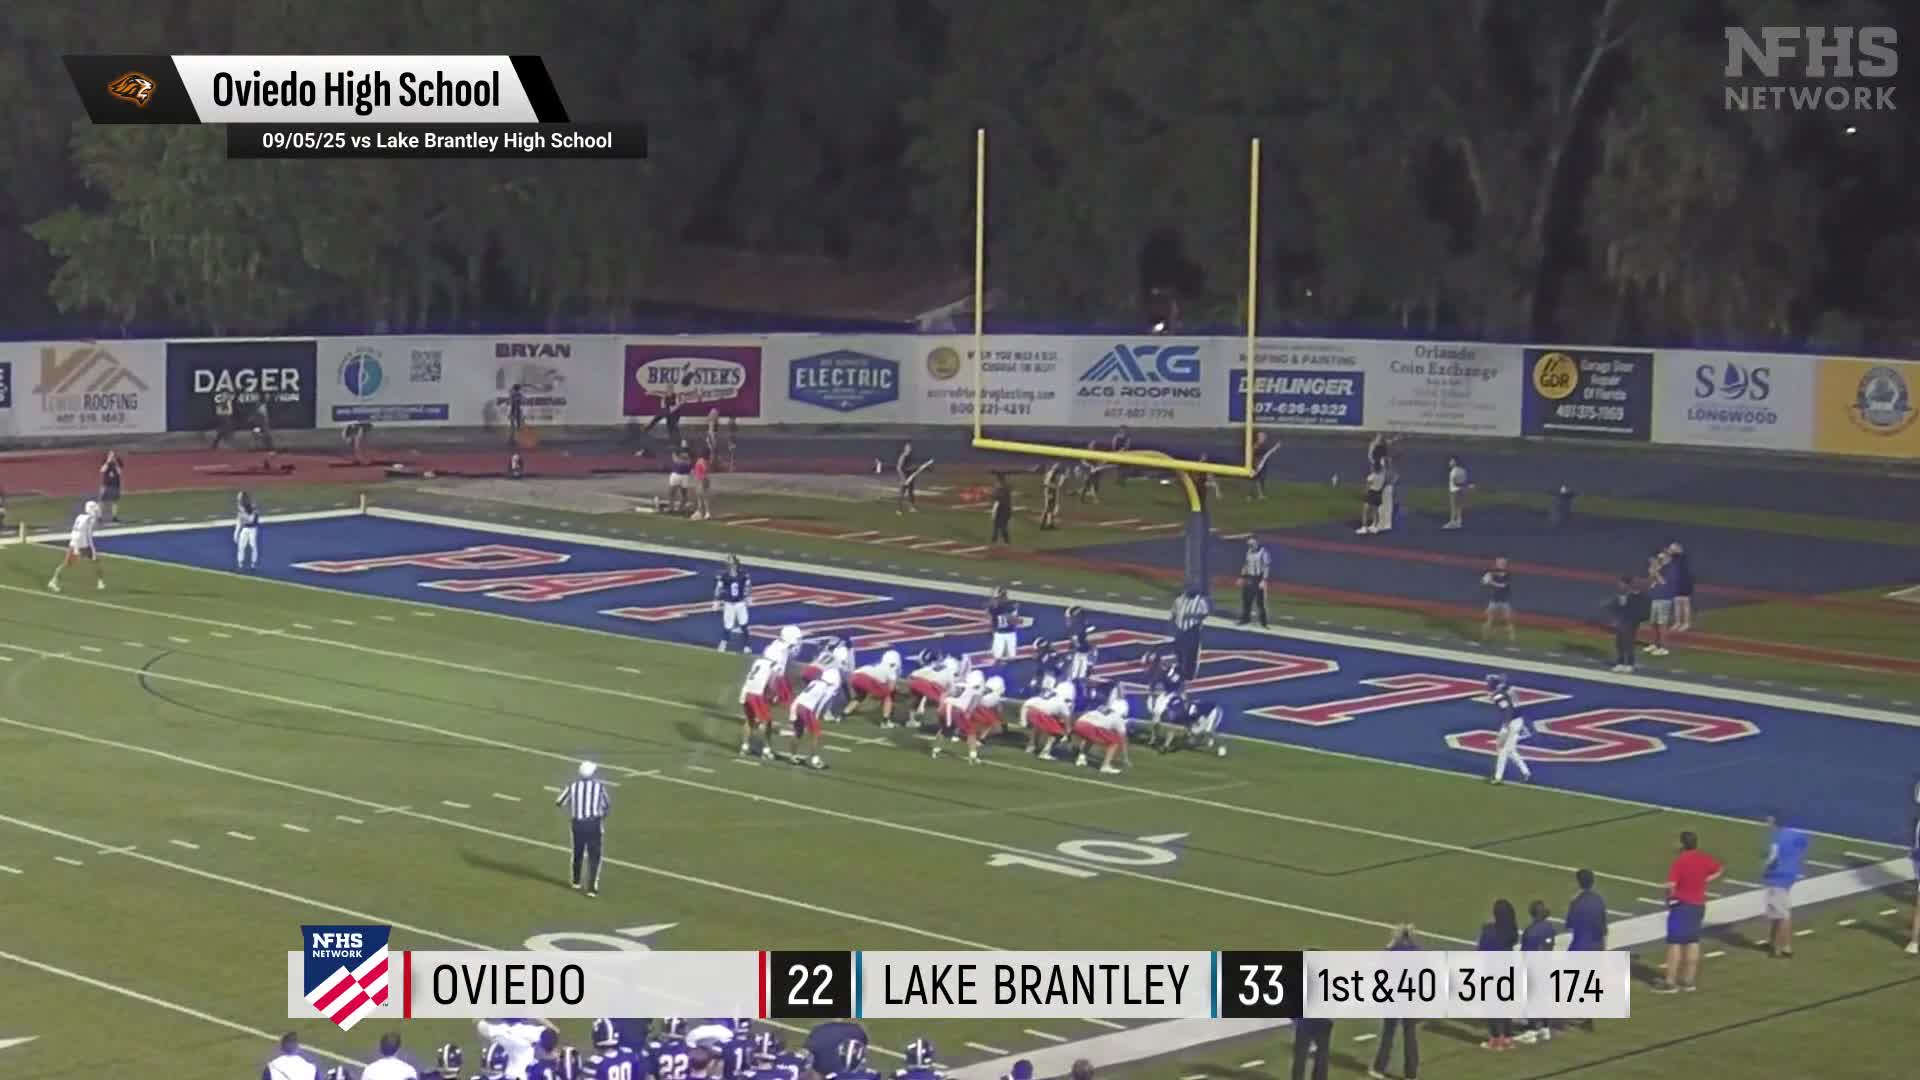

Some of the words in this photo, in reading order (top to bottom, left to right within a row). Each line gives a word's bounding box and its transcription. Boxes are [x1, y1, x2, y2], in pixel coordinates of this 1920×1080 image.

[495, 343, 571, 358] BRYAN
[194, 368, 300, 393] DAGER
[795, 367, 893, 389] ELECTRIC
[1540, 374, 1570, 388] GDR
[1077, 386, 1115, 397] ACG
[1120, 386, 1201, 399] ROOFING
[83, 393, 138, 411] ROOFING
[1687, 407, 1778, 425] LONGWOOD
